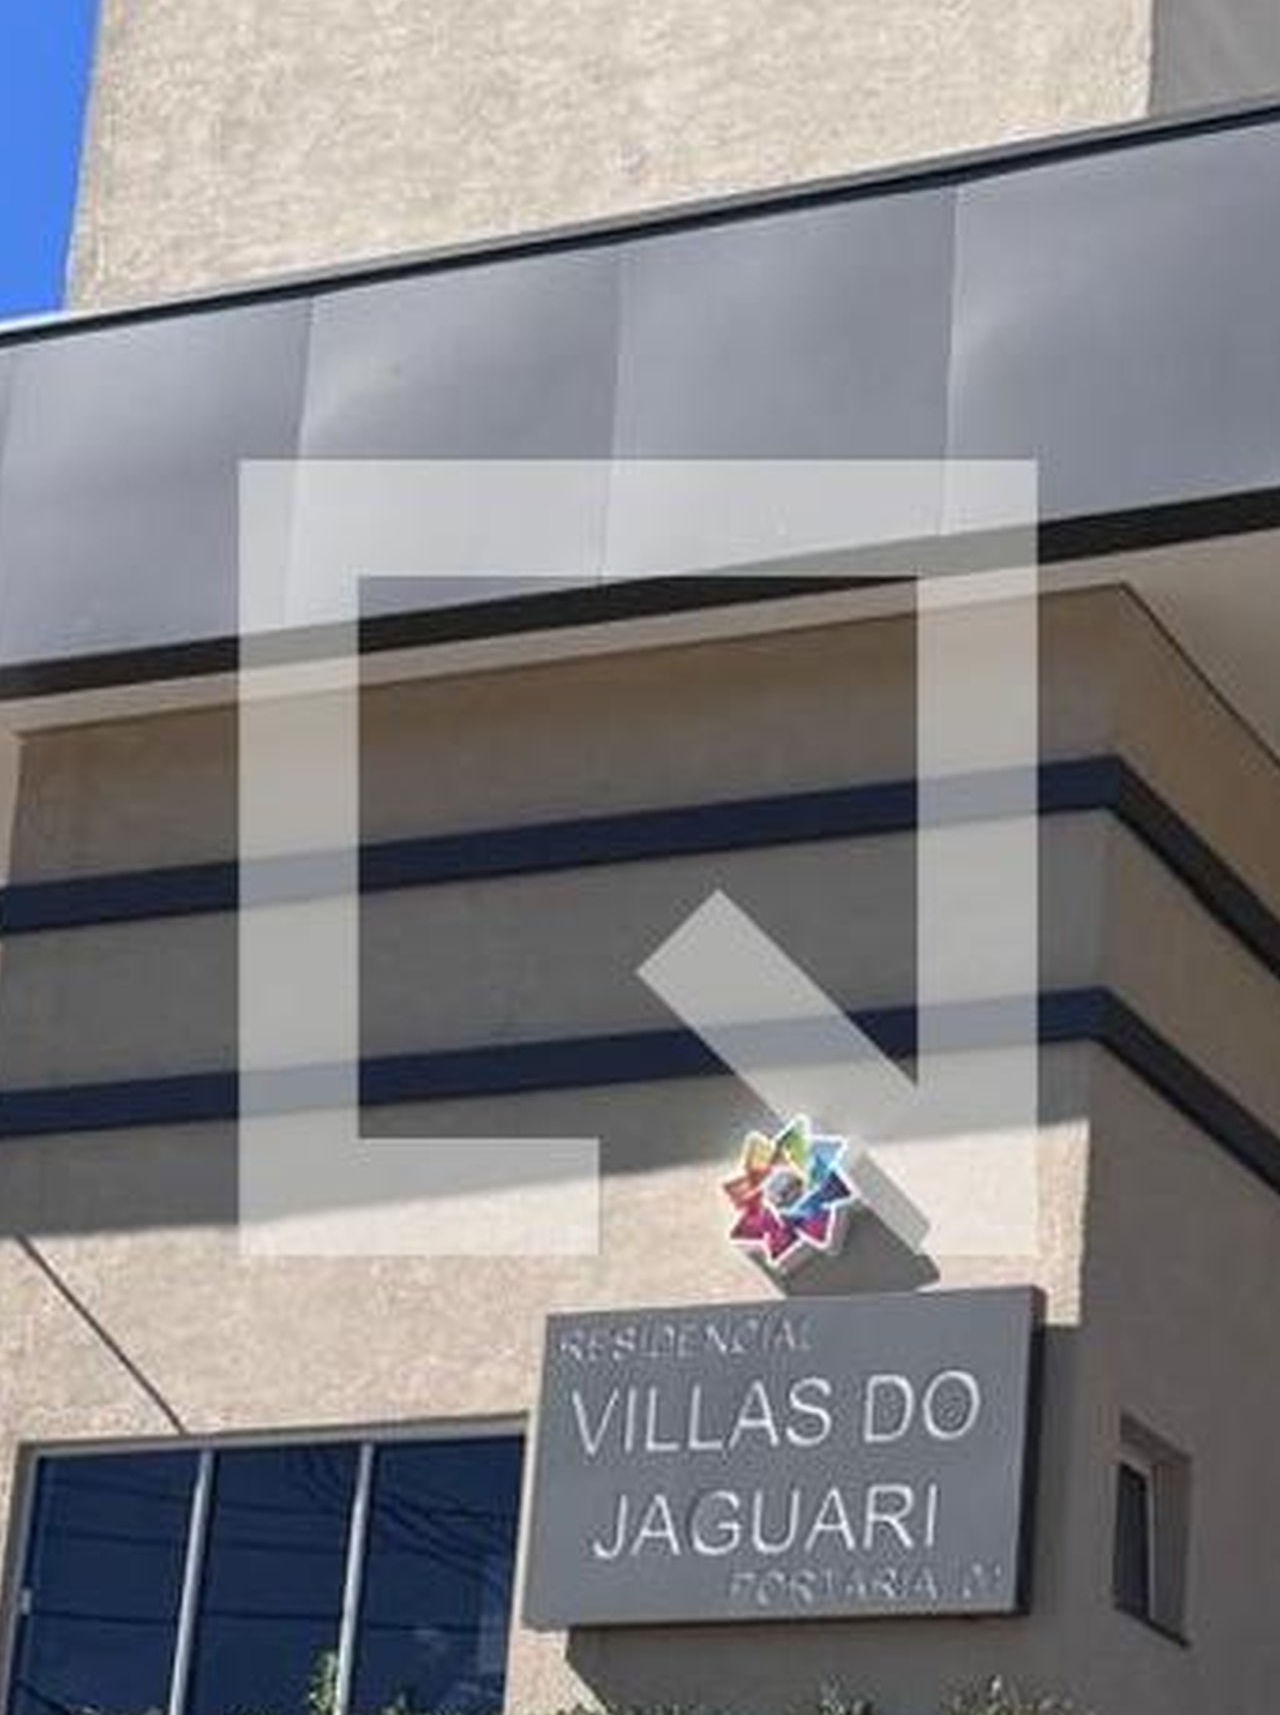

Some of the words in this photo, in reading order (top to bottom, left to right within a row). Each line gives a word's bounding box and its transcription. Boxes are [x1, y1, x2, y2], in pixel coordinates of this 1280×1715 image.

[559, 1317, 812, 1361] RESIDENCIAL
[572, 1377, 833, 1456] VILLAS
[863, 1370, 981, 1443] DO
[592, 1483, 938, 1560] JAGUARI
